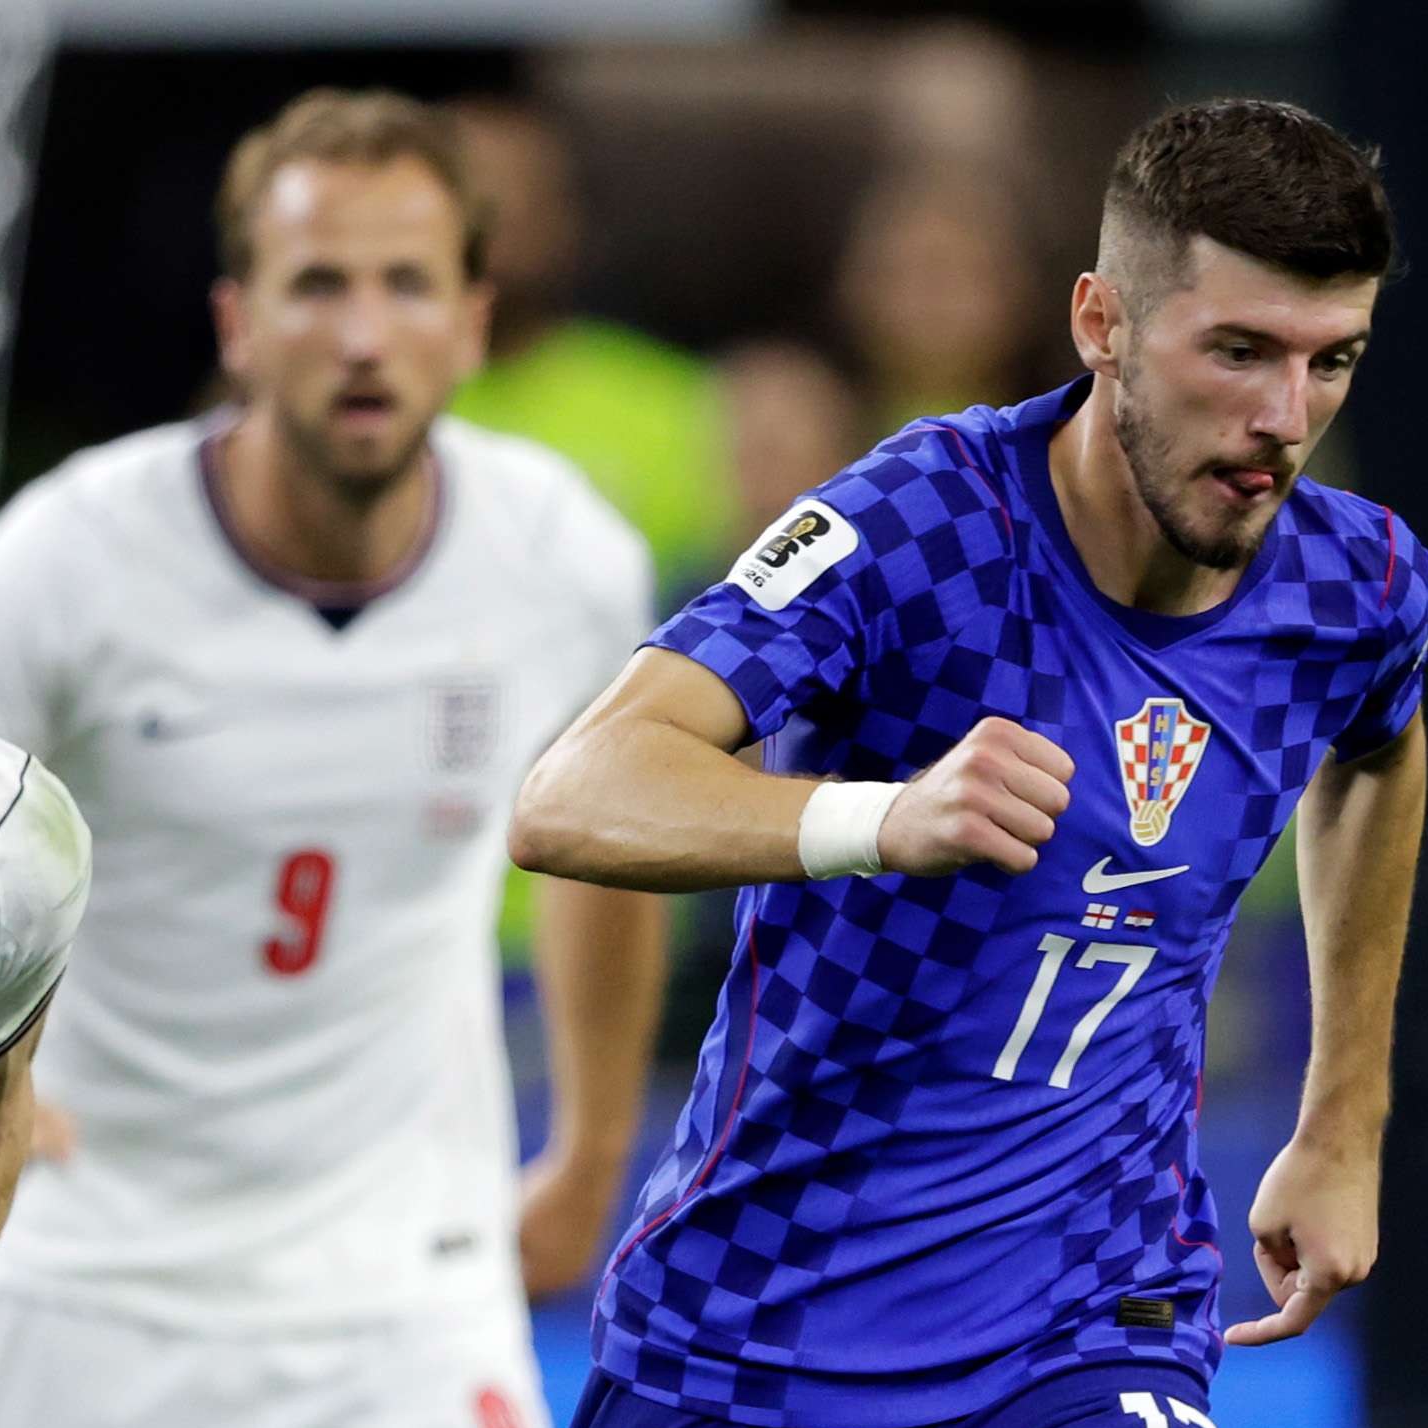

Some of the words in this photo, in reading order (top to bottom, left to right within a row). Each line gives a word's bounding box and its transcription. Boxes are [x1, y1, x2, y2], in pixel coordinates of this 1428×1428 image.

[1150, 714, 1170, 787] HNS
[264, 850, 334, 977] 9
[991, 932, 1159, 1090] 17
